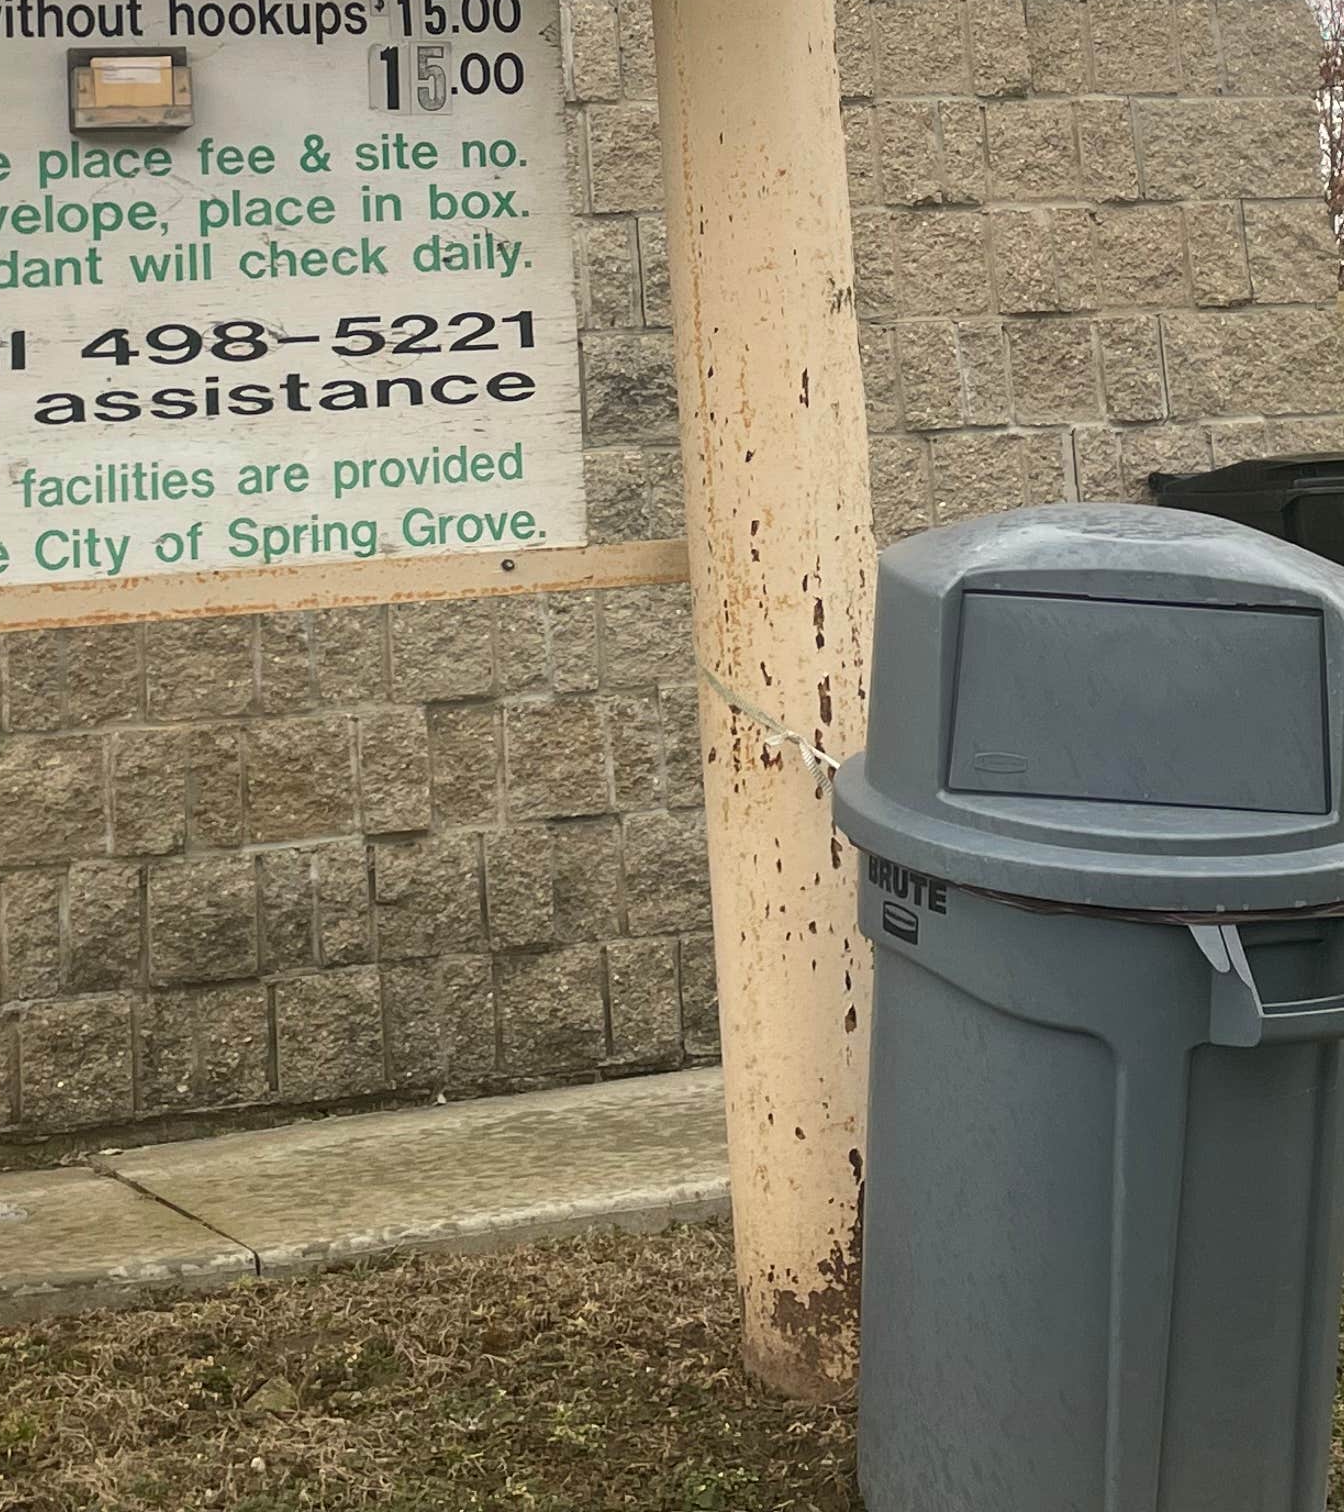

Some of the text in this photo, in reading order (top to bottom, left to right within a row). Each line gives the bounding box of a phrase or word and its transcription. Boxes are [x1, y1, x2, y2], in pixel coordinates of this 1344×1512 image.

[380, 46, 524, 111] 15.00
[39, 141, 172, 189] place
[197, 138, 275, 175] fee
[299, 134, 331, 173] &
[356, 133, 438, 171] site
[461, 139, 527, 168] no.
[199, 190, 335, 237] place
[361, 185, 402, 222] in
[429, 184, 529, 220] box.
[129, 243, 212, 282] will
[239, 237, 388, 279] check
[413, 233, 532, 278] daily.
[81, 310, 535, 366] 498-5221
[34, 371, 536, 425] assistance
[19, 462, 215, 508] facilities
[238, 462, 309, 495] are
[334, 442, 523, 499] provided
[34, 528, 131, 576] City
[155, 522, 203, 563] of
[228, 514, 378, 564] Spring
[402, 507, 547, 548] Grove.
[868, 854, 947, 915] BRUTE
